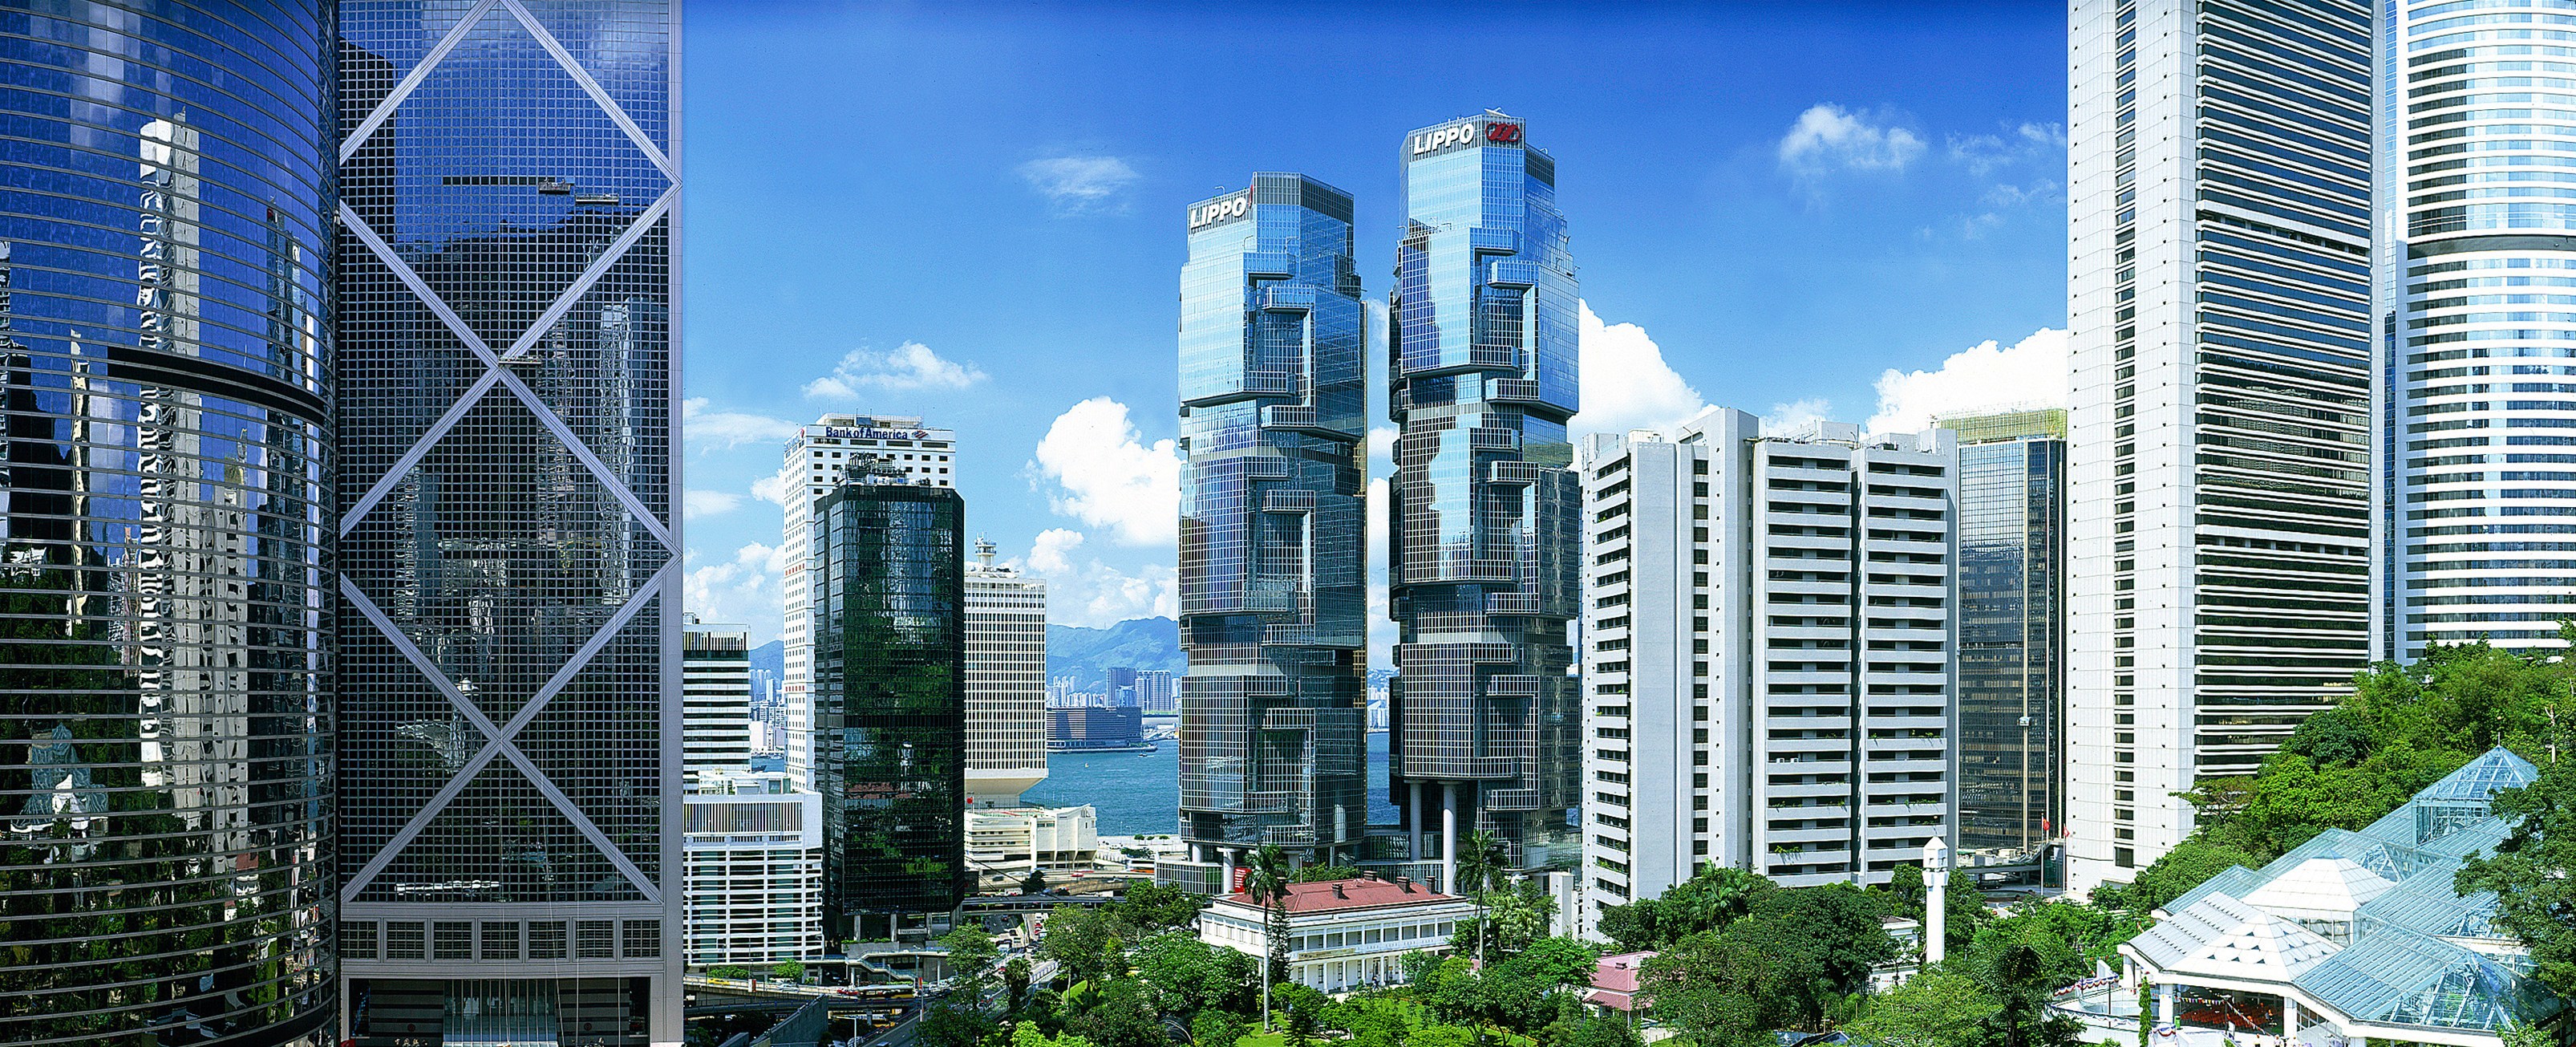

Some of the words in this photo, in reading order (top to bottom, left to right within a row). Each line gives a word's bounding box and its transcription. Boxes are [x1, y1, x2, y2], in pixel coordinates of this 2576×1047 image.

[1413, 123, 1474, 154] LIPPO
[1190, 197, 1246, 229] LIPPO
[826, 426, 852, 437] Bank
[853, 427, 865, 438] of
[865, 428, 908, 440] America
